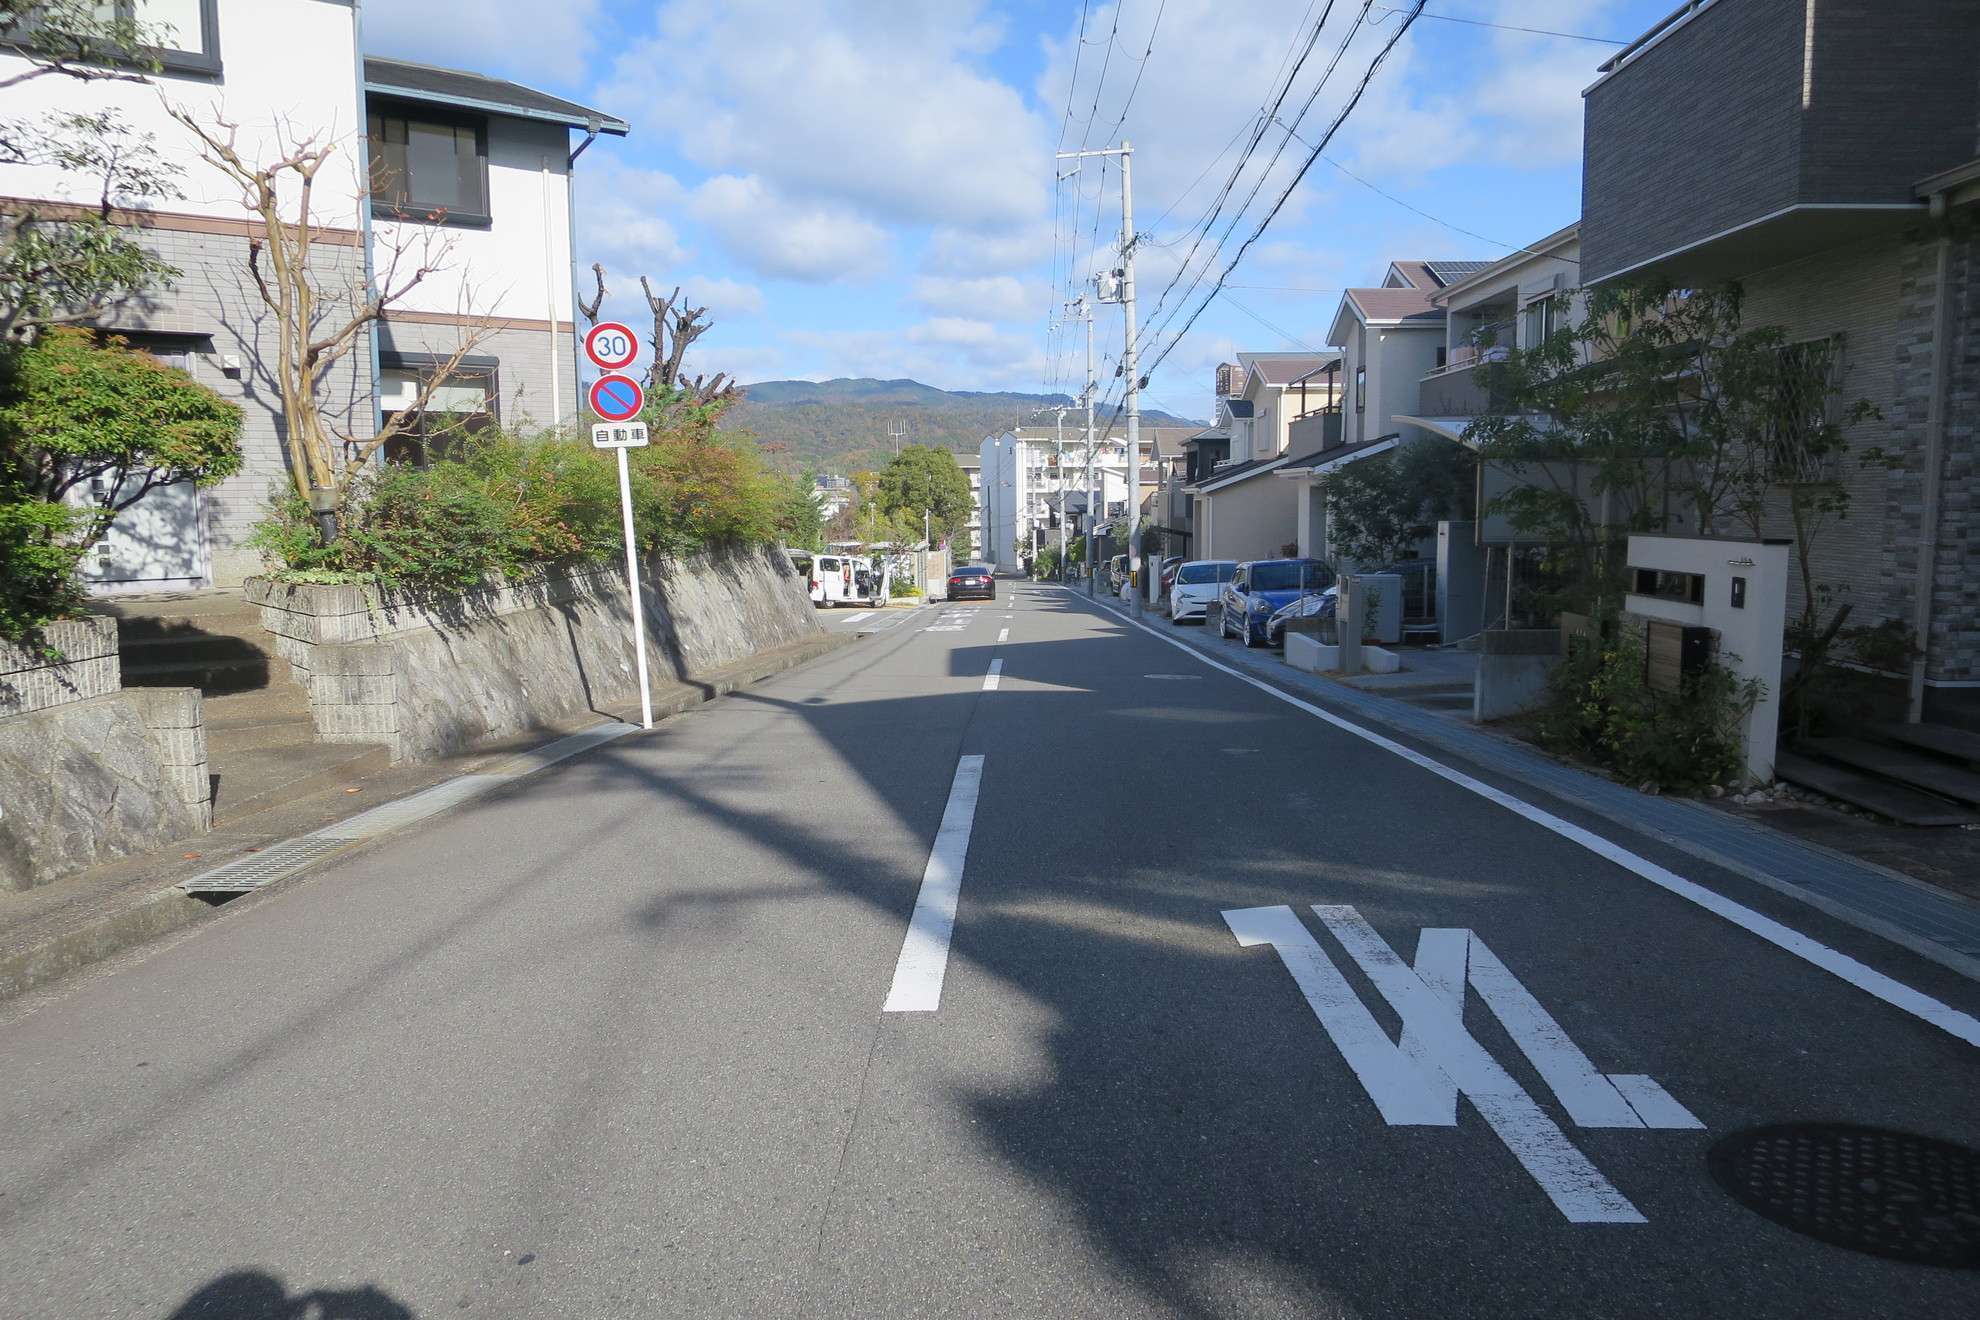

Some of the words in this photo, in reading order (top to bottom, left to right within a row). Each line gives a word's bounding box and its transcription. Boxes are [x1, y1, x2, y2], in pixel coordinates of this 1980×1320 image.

[598, 336, 626, 356] 30
[596, 428, 645, 442] 自動車
